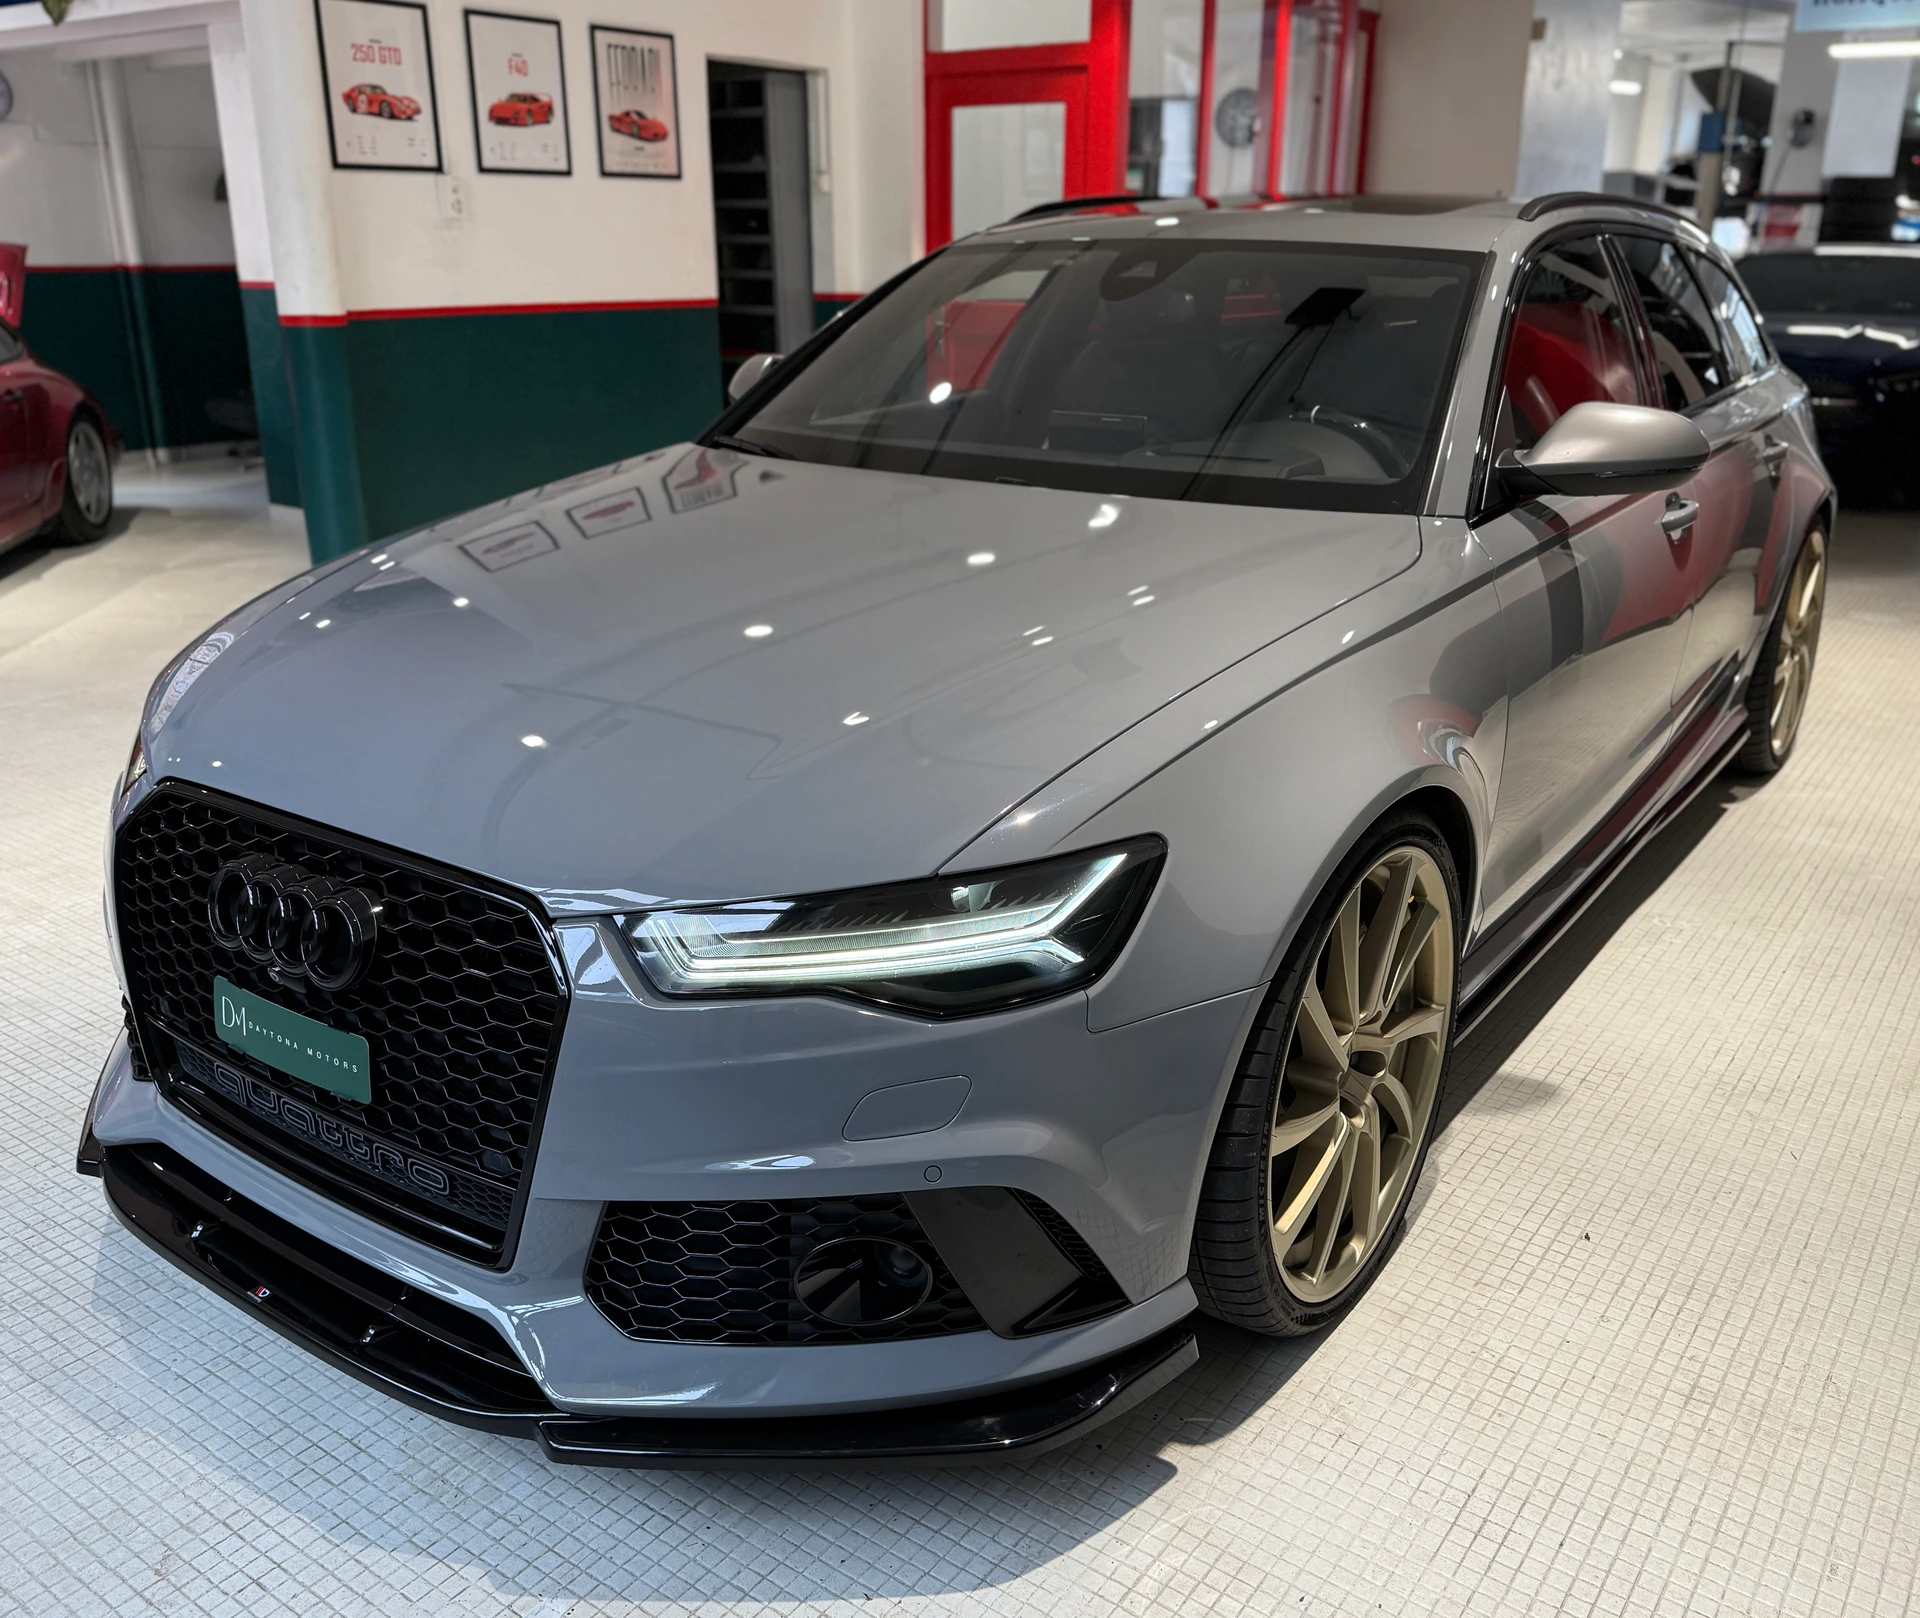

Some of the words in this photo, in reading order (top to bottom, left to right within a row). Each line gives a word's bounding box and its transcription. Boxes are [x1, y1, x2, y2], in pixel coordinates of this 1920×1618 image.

[350, 43, 376, 63] 250
[378, 45, 403, 66] GTO
[507, 57, 529, 78] F40
[248, 1021, 299, 1050] DAYTONA
[307, 1047, 358, 1073] MOTORS
[213, 1061, 450, 1195] quattro
[1259, 1120, 1270, 1222] MICHELIN
